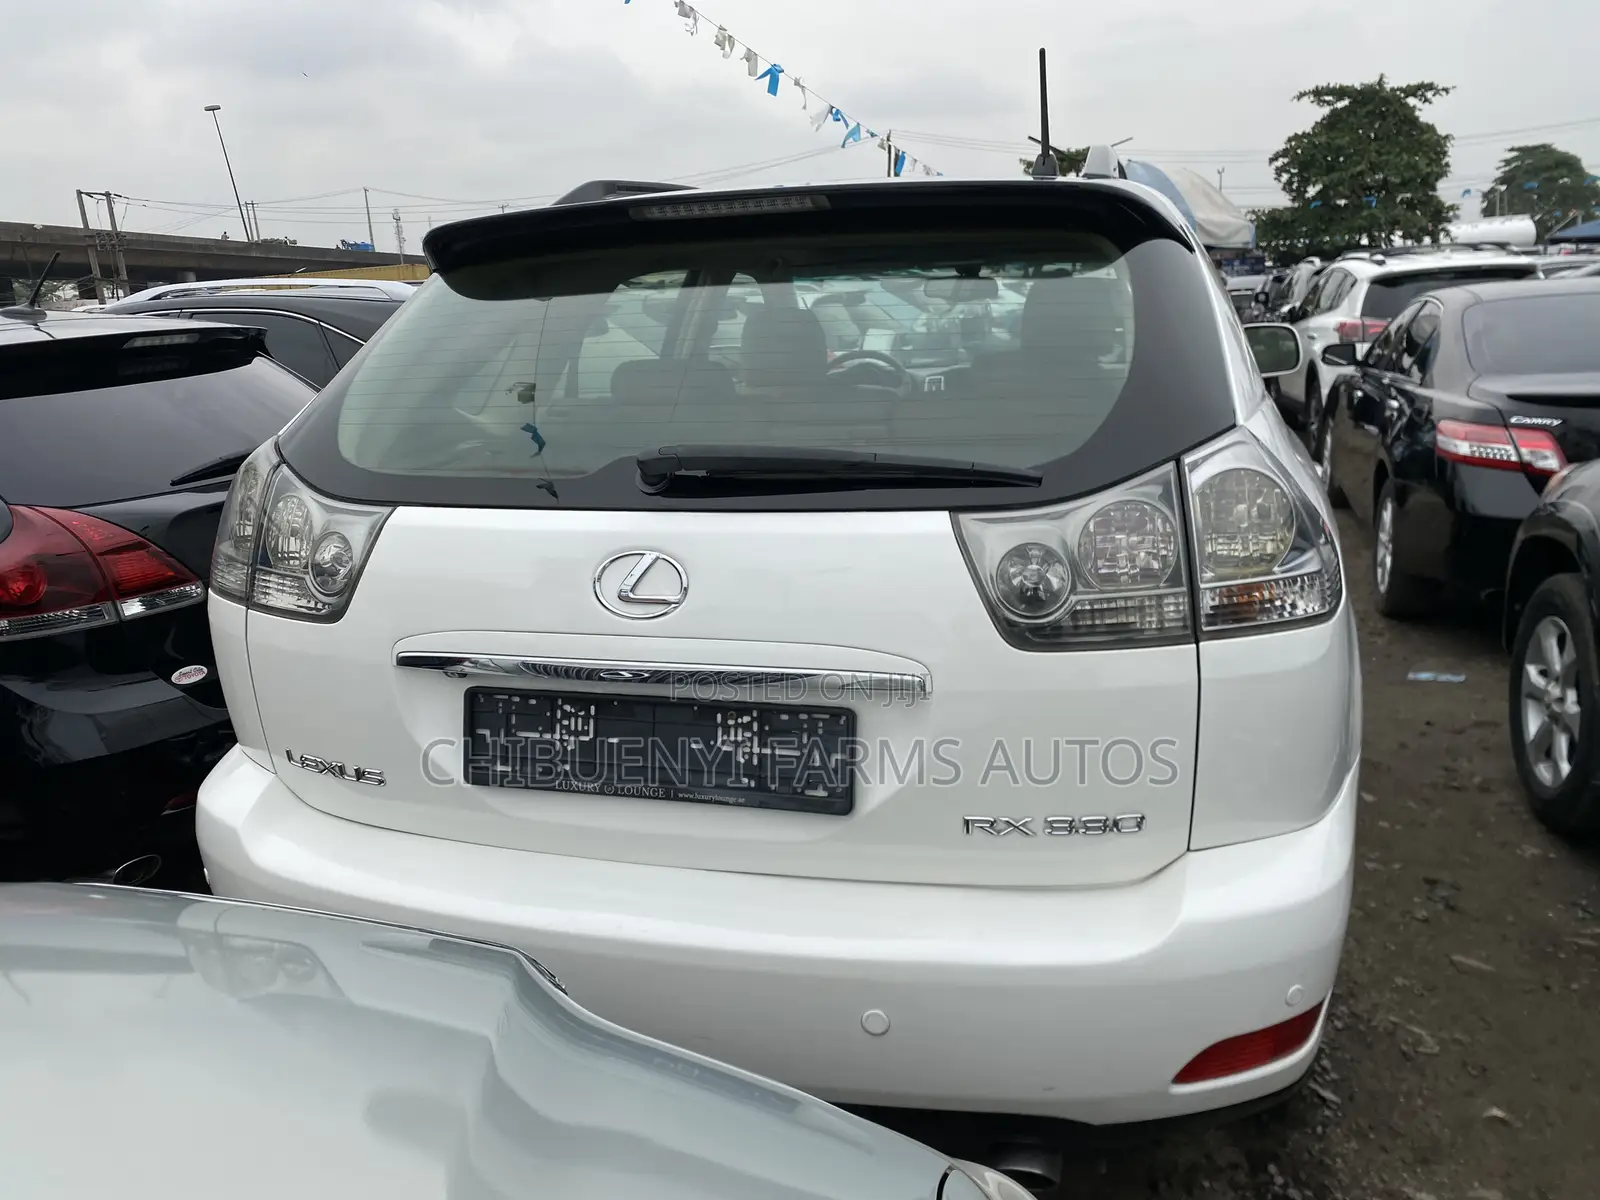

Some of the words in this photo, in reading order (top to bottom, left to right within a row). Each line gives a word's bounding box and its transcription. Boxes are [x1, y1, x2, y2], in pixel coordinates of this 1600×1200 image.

[285, 747, 386, 786] LEXUS
[555, 780, 601, 793] LUXURY
[617, 785, 666, 798] LOUNGE
[963, 815, 1037, 836] RX
[1044, 813, 1147, 836] 330
